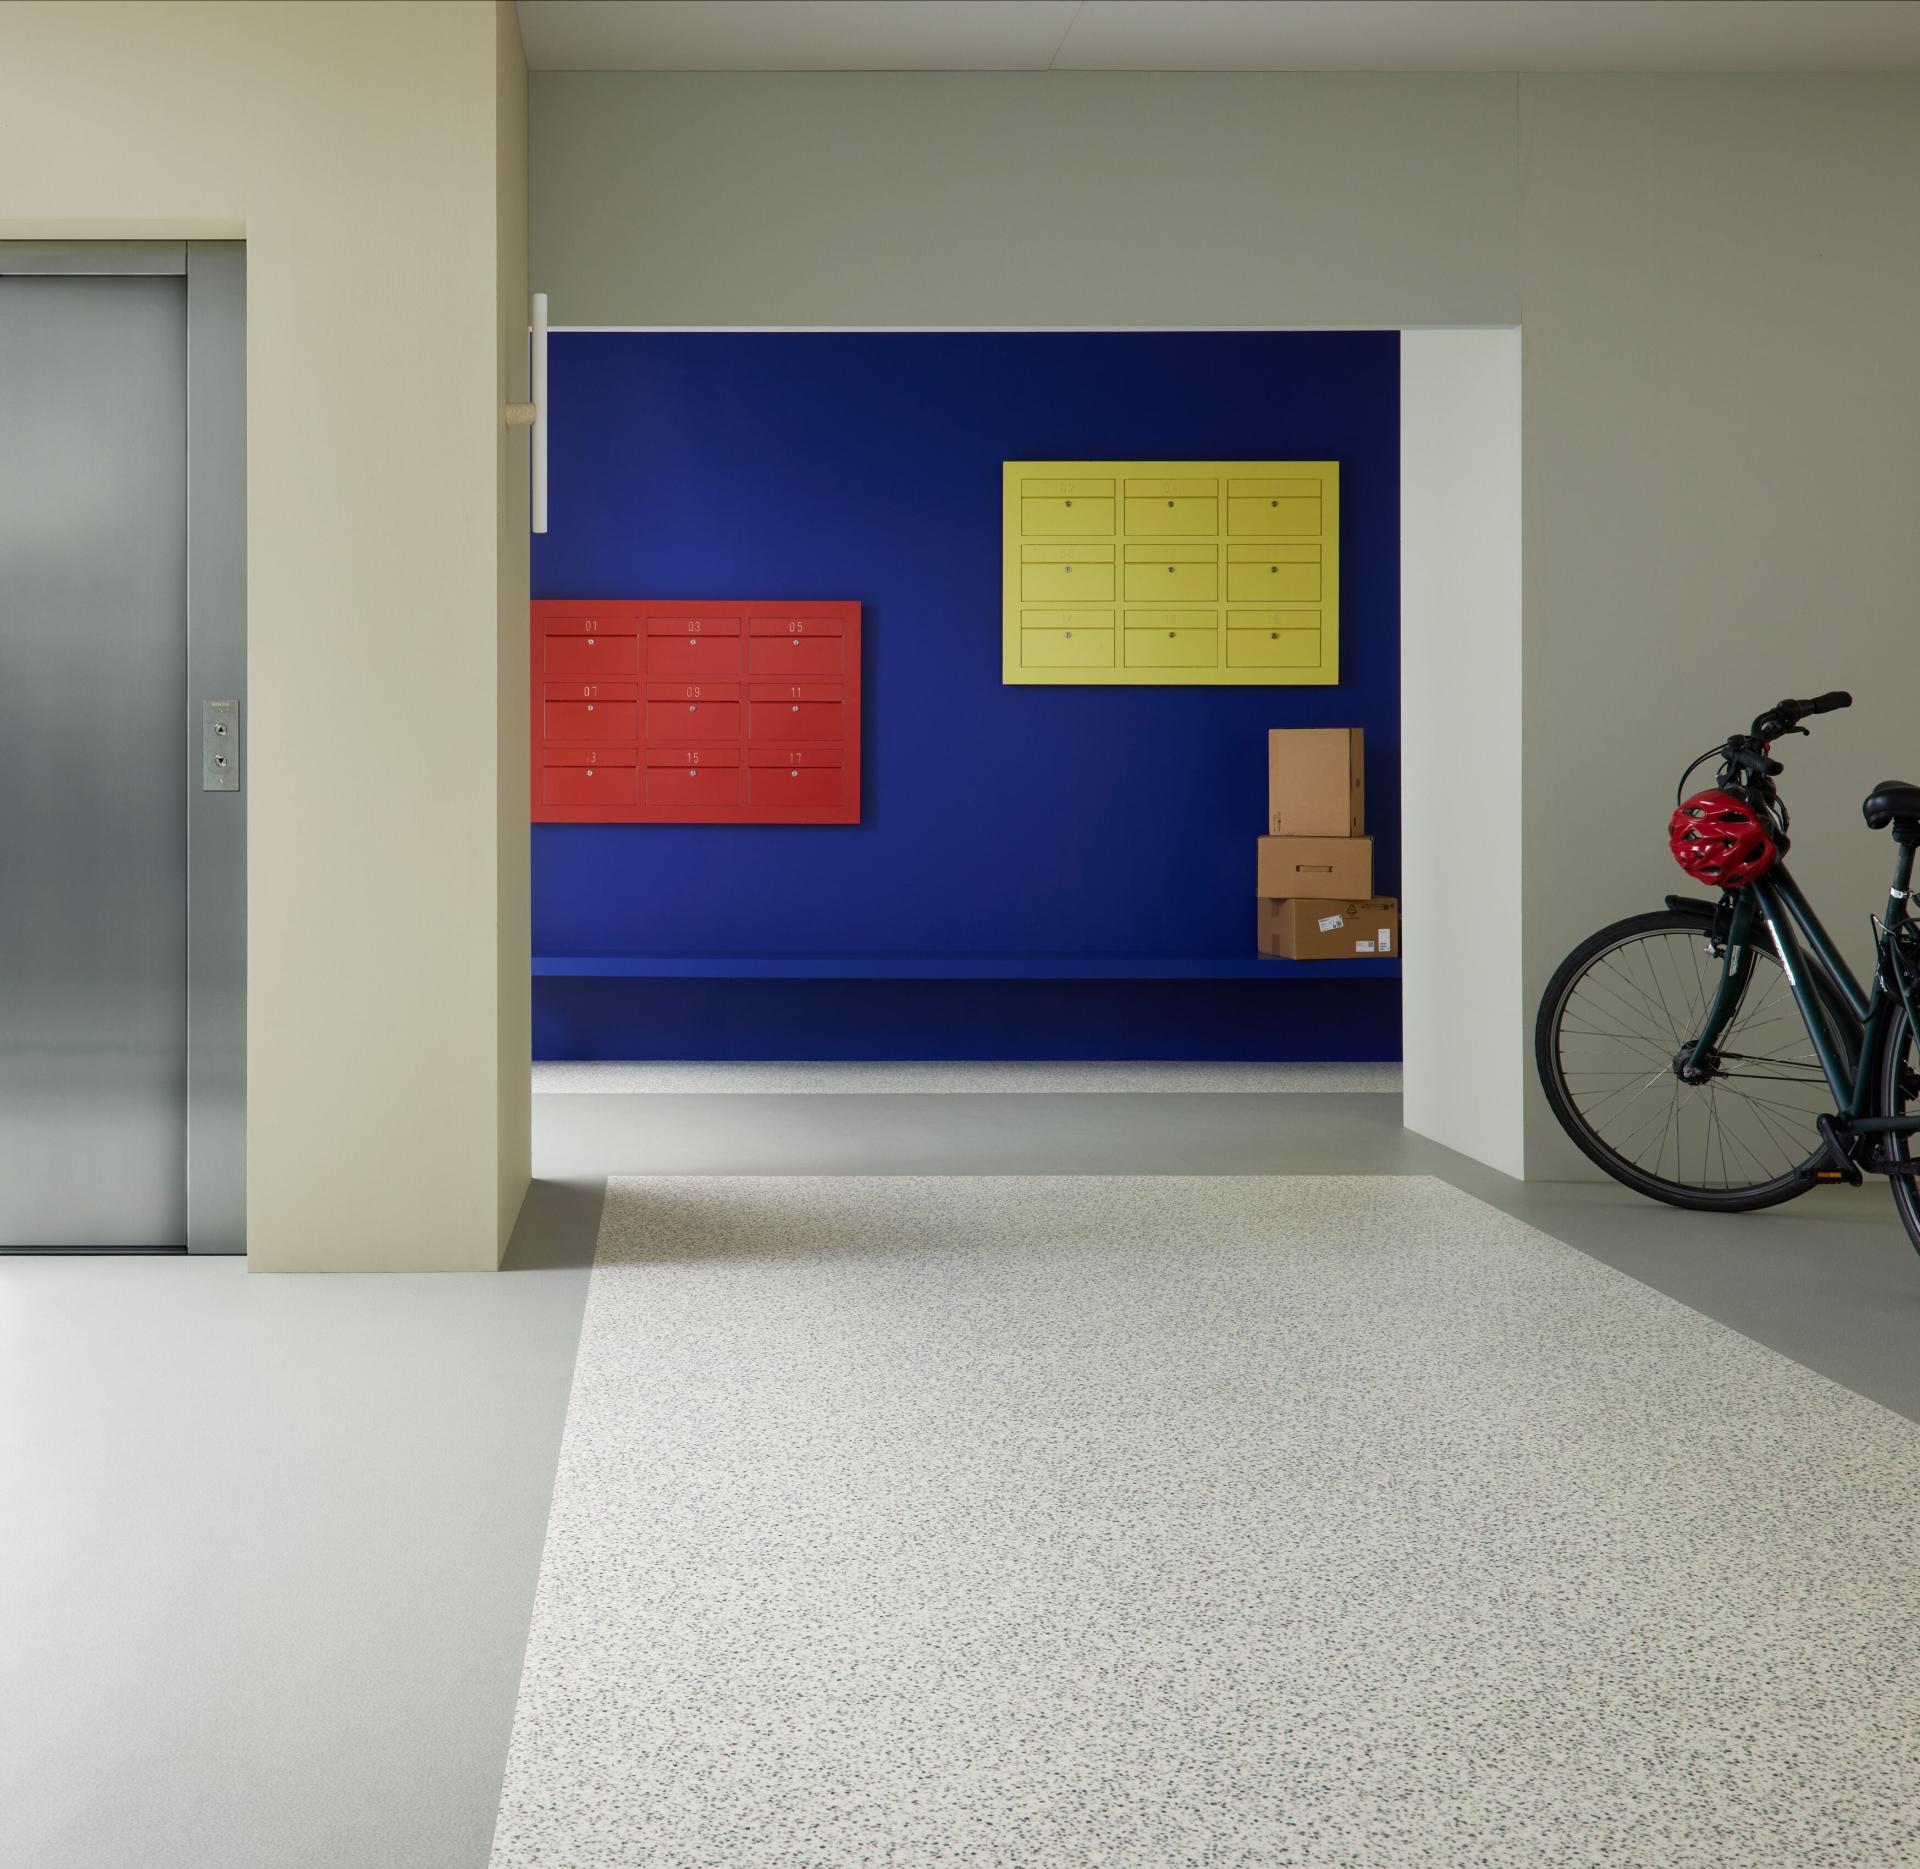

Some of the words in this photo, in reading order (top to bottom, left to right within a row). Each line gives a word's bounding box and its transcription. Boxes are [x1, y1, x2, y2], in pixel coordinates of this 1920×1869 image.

[585, 620, 597, 632] 01
[688, 621, 701, 632] 03
[790, 621, 803, 633] 05
[584, 686, 597, 697] 07
[686, 686, 700, 698] 09
[792, 687, 801, 697] 11
[688, 752, 699, 763] 15
[790, 752, 802, 764] 17
